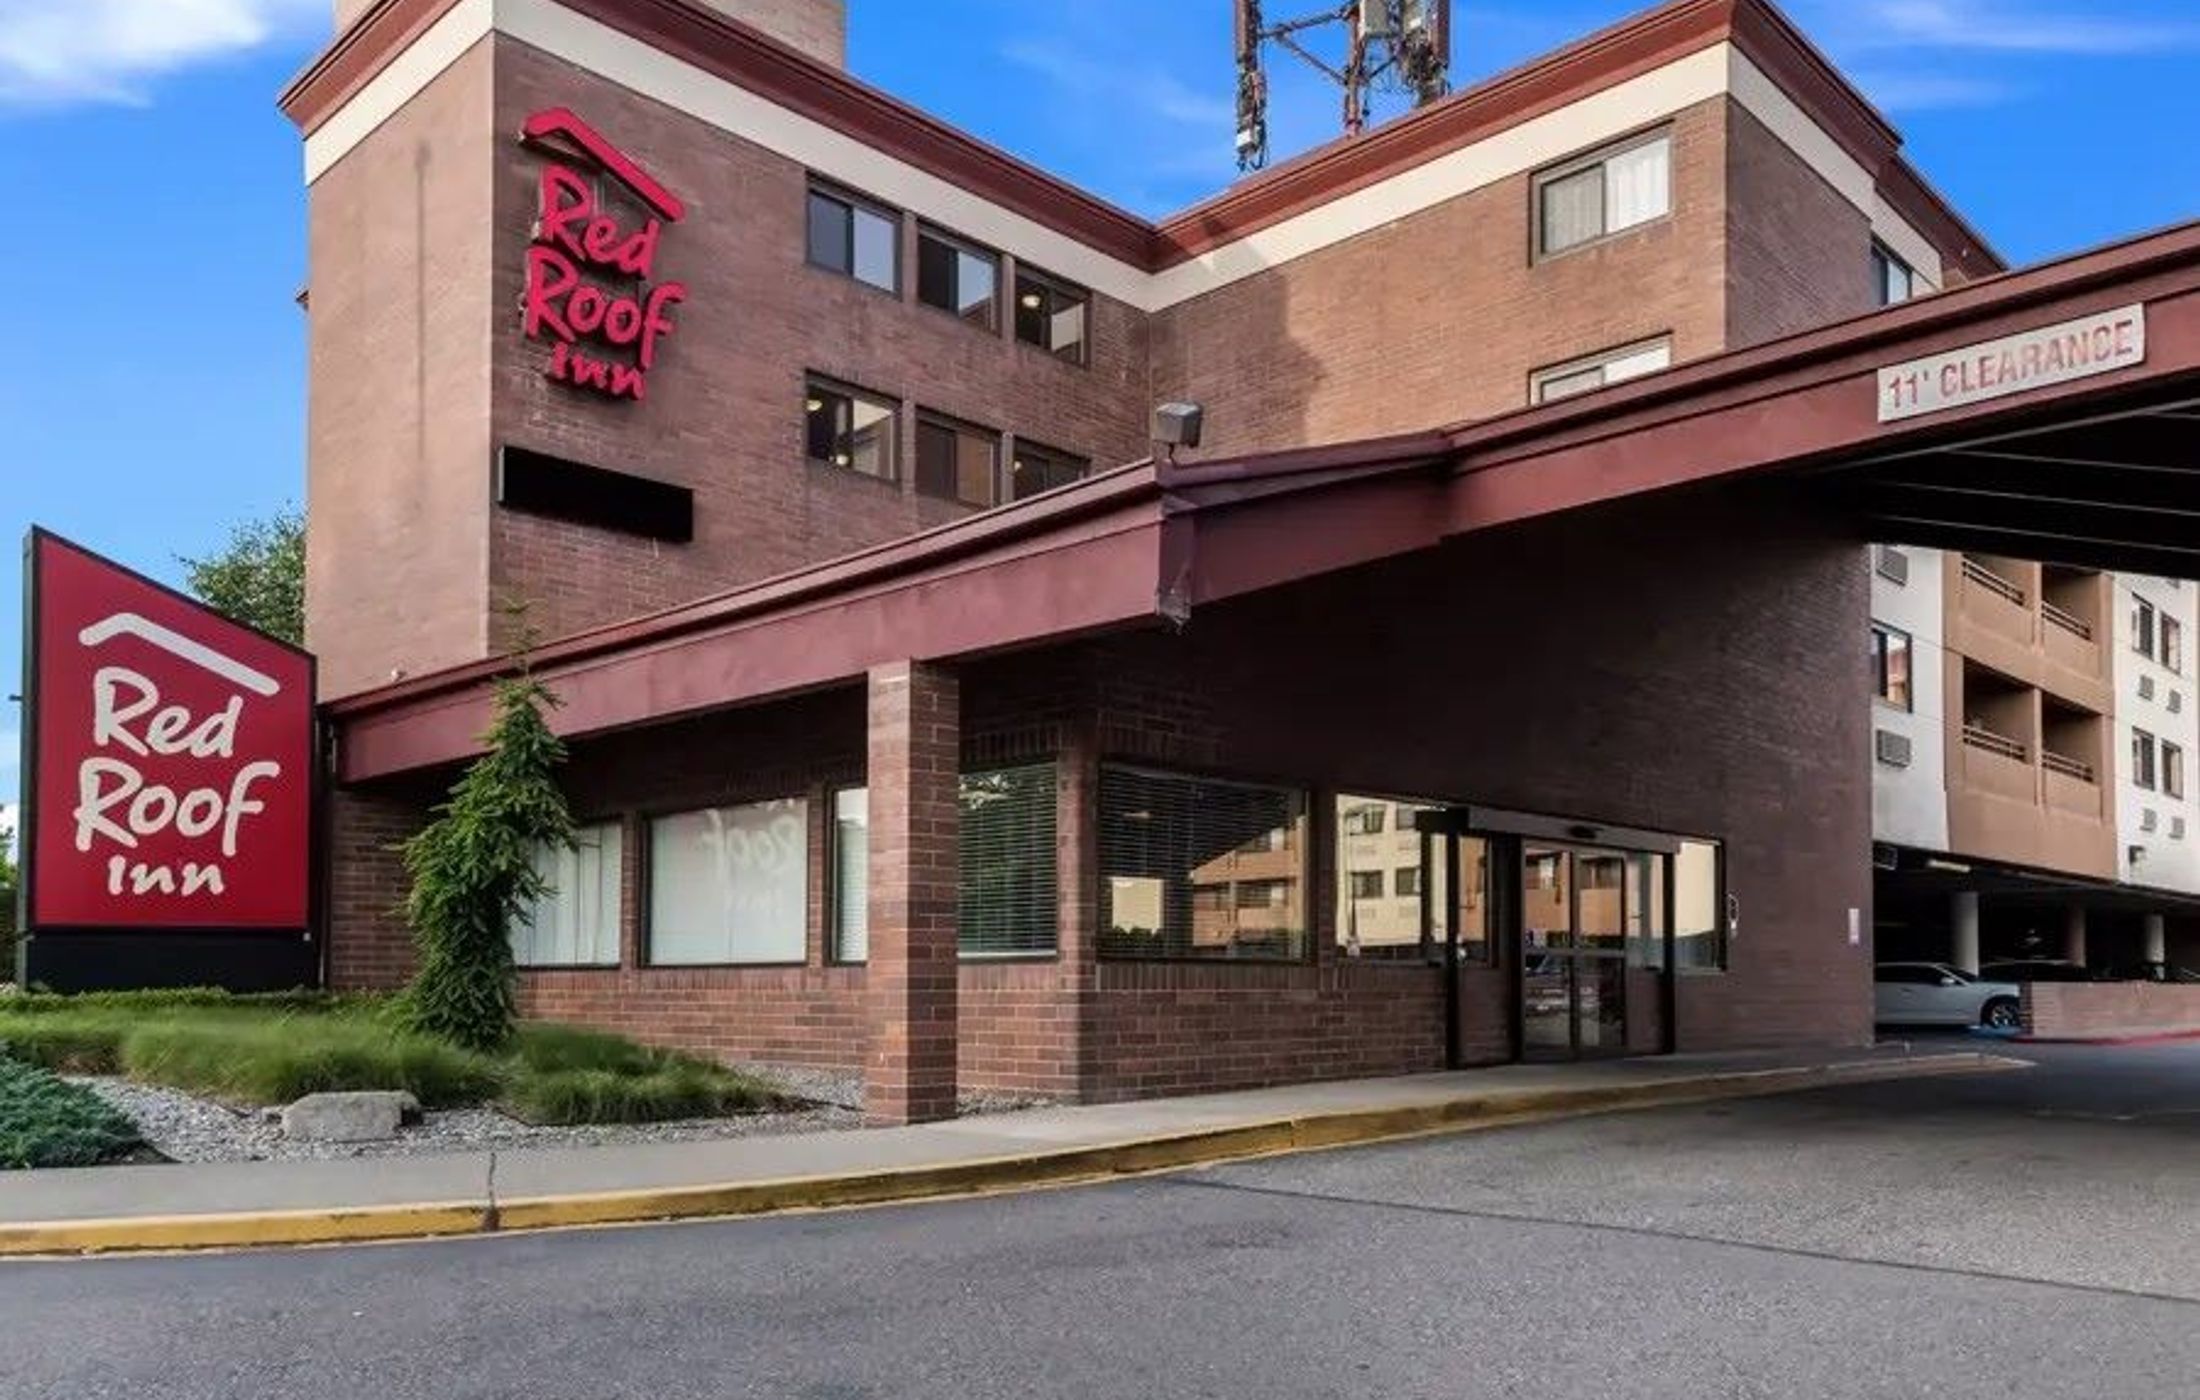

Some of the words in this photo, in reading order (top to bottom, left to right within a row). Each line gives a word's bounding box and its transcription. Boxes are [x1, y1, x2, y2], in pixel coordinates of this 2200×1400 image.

[541, 166, 659, 275] Red
[525, 246, 687, 368] Roof
[1940, 319, 2133, 398] CLEARANCE
[94, 666, 243, 757] Red
[74, 757, 280, 857] Roof
